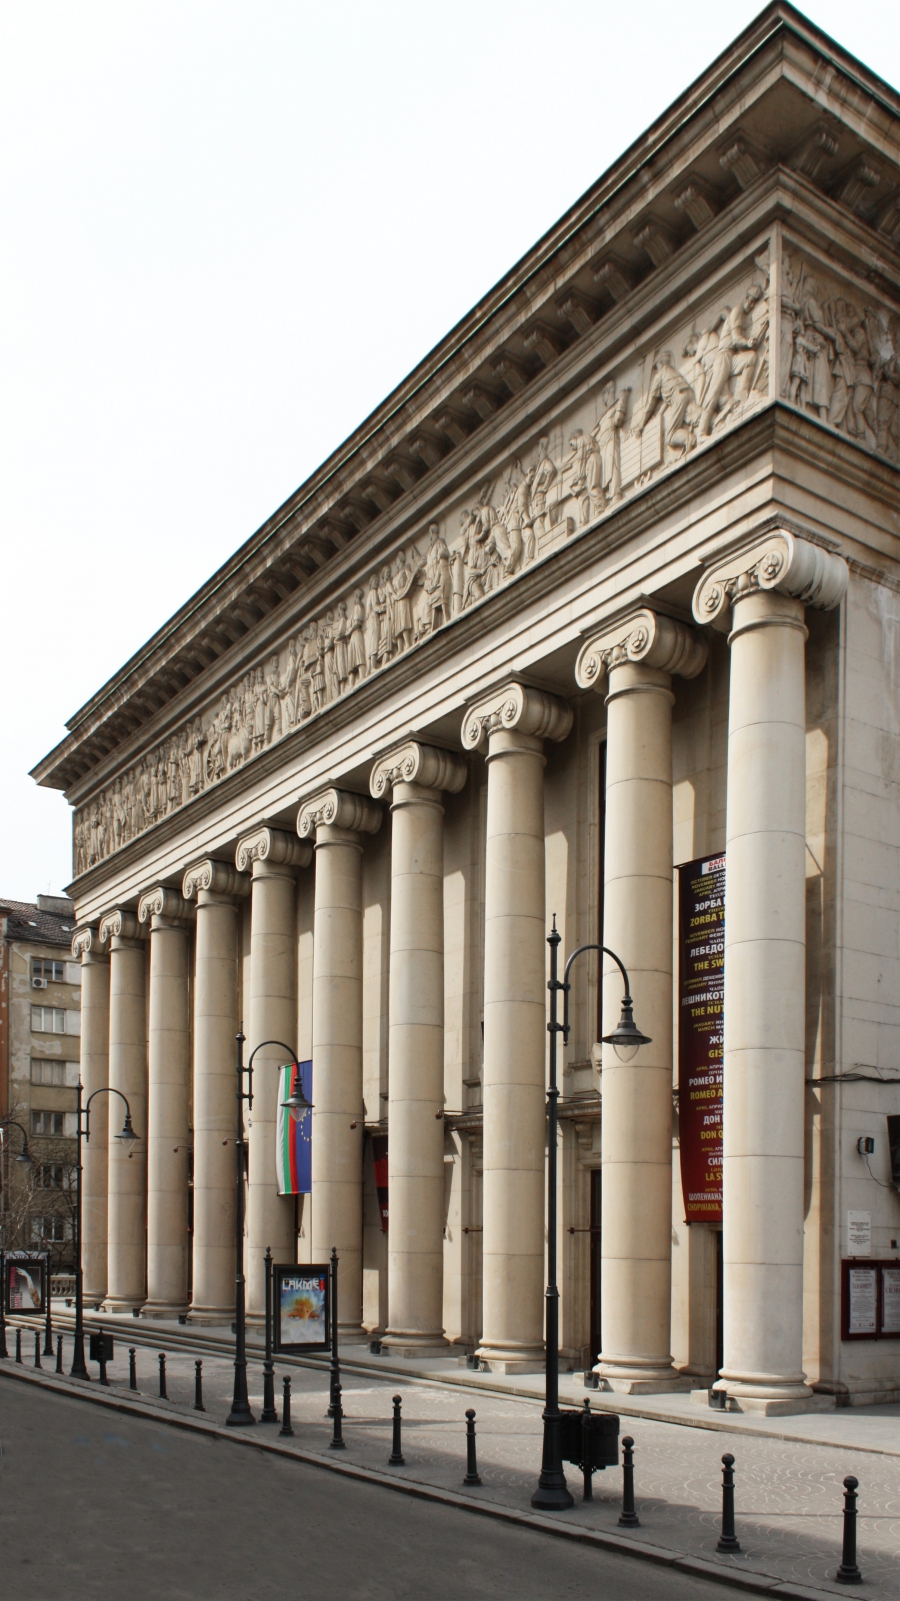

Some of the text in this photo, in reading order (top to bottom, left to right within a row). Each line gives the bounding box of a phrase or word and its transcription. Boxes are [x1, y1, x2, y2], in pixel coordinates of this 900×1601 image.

[694, 898, 722, 912] ЗОРБА
[690, 914, 717, 926] ZORBA
[690, 944, 724, 957] ЛЕБЕДО
[694, 960, 709, 971] THE
[691, 1007, 705, 1017] THE
[689, 1075, 723, 1086] РОМЕО И
[690, 1090, 716, 1100] ROMEO
[704, 1115, 720, 1125] ДОН
[701, 1131, 716, 1139] DON
